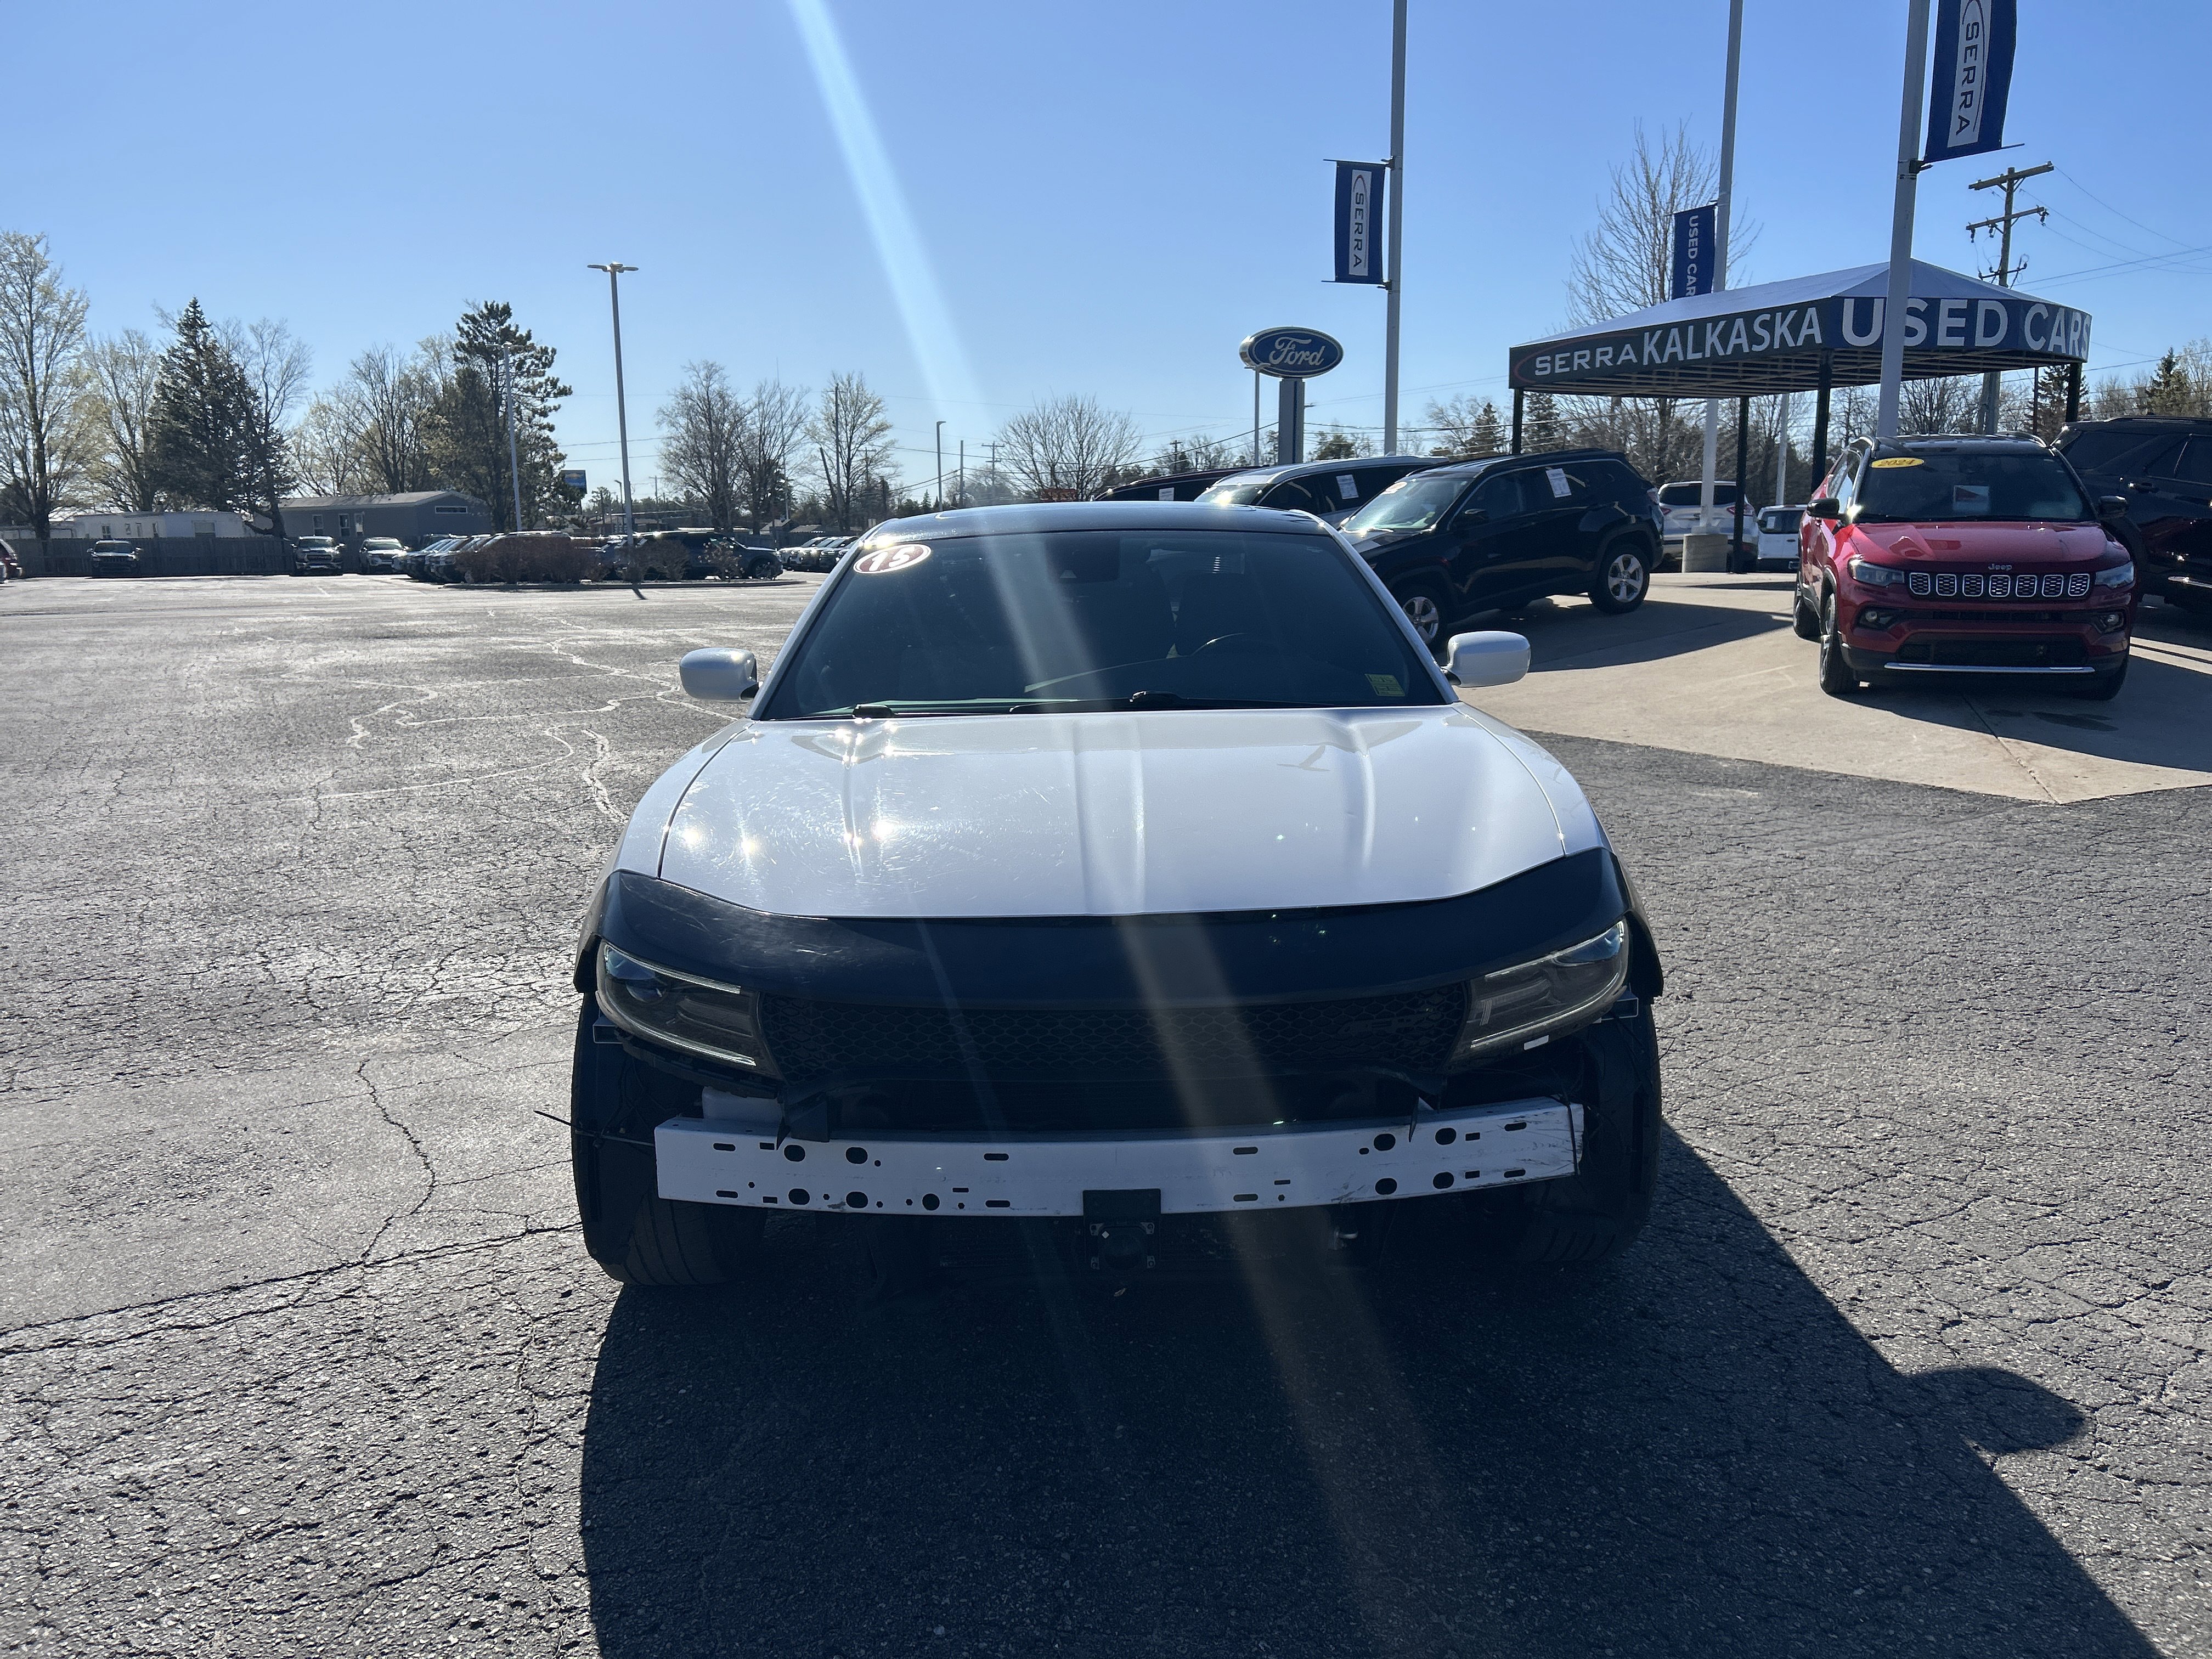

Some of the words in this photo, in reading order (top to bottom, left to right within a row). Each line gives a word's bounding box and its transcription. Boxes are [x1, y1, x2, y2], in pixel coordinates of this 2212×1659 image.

[1956, 21, 1980, 136] SERRA
[1353, 192, 1364, 268] SERRA
[1689, 215, 1699, 259] USED
[1268, 336, 1325, 366] Ford
[1535, 343, 1638, 375] SERRA
[1643, 307, 1822, 365] KALKASKA
[1842, 298, 2008, 347] USED
[2024, 303, 2091, 360] CARS
